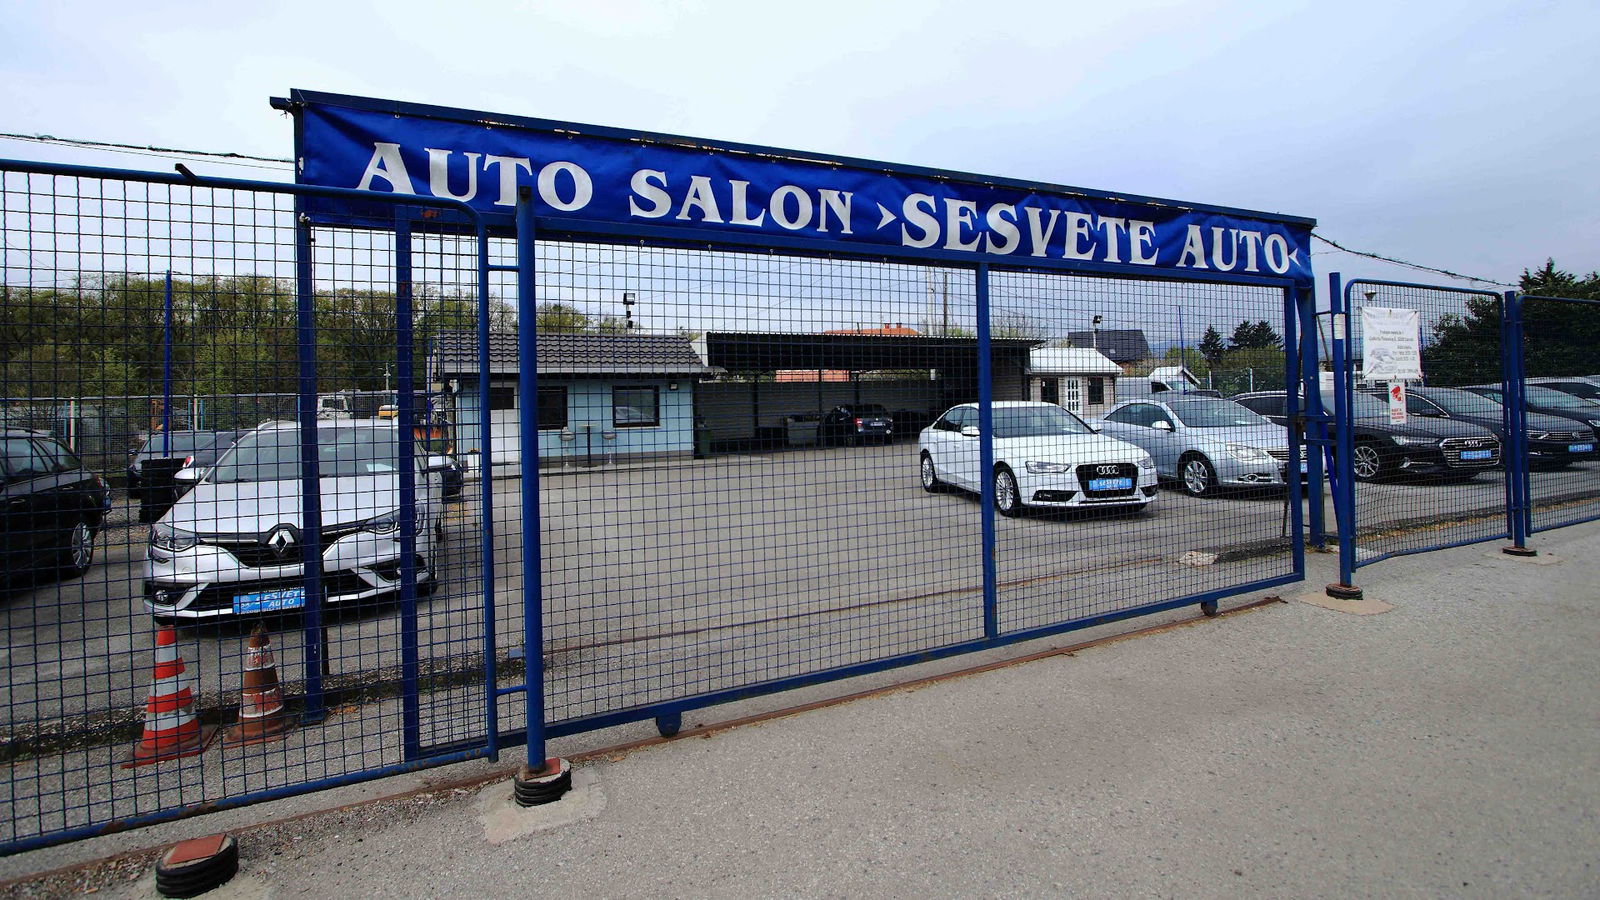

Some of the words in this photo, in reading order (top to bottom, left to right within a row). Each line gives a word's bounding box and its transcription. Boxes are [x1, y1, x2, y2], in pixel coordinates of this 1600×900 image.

[356, 142, 593, 212] AUTO
[629, 169, 853, 234] SALON
[901, 192, 1160, 267] SESVETE
[1176, 224, 1290, 275] AUTO
[268, 598, 295, 608] AUTO
